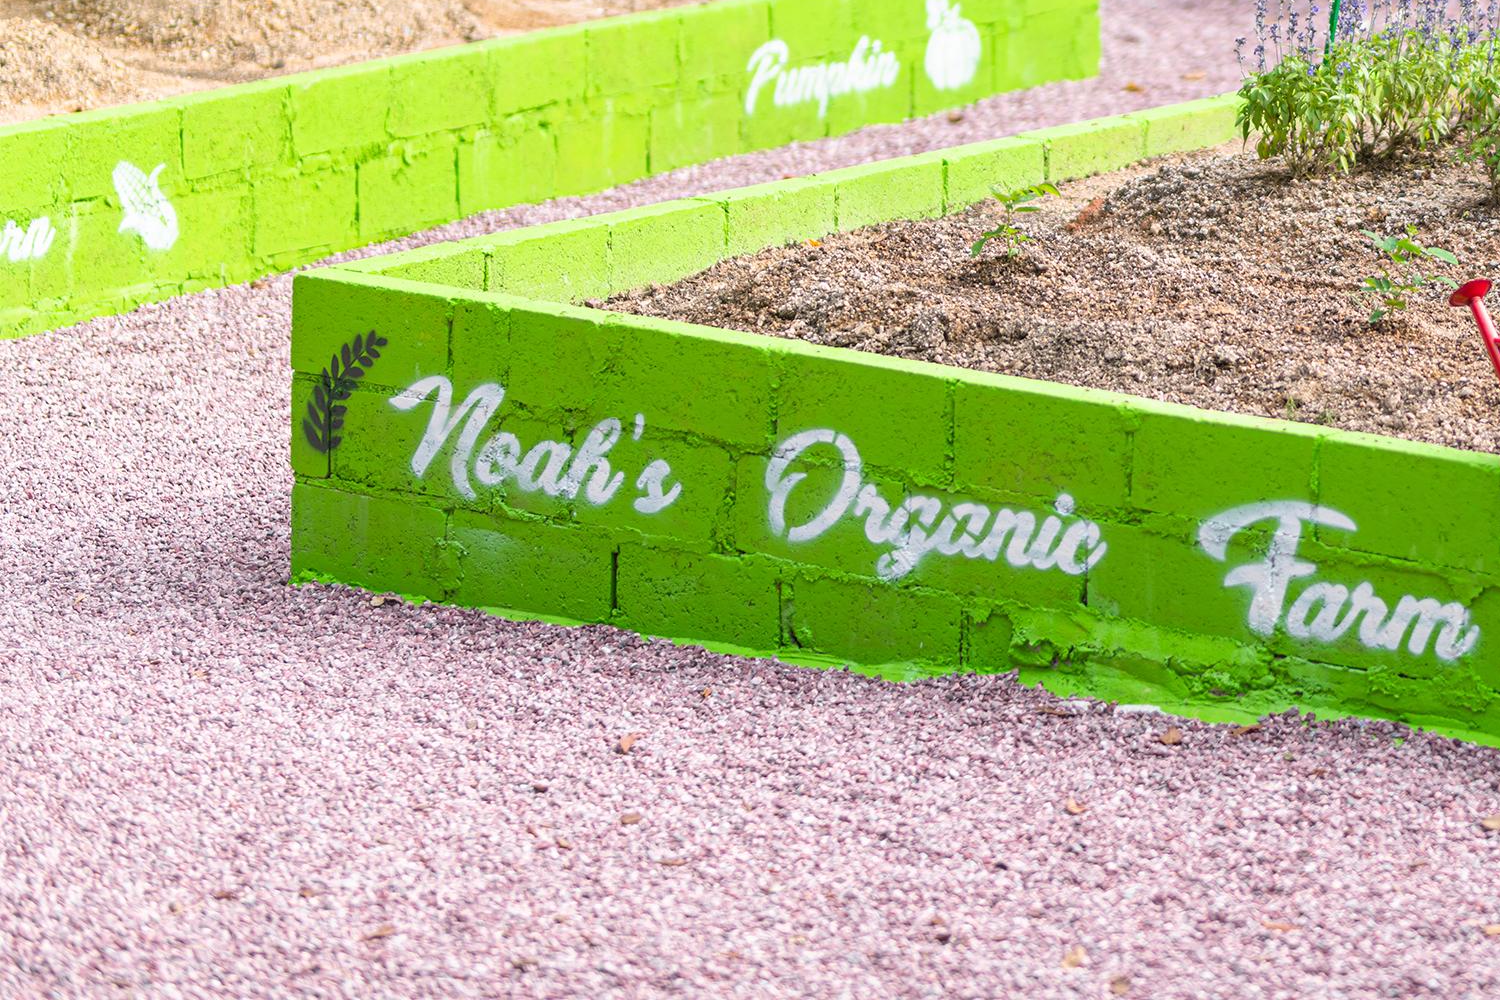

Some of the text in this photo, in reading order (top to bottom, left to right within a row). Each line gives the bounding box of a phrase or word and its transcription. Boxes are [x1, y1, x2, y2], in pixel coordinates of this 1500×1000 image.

[745, 34, 900, 119] Pumpkin
[0, 215, 57, 263] rn
[388, 375, 1480, 661] Noah's Organic Farm
